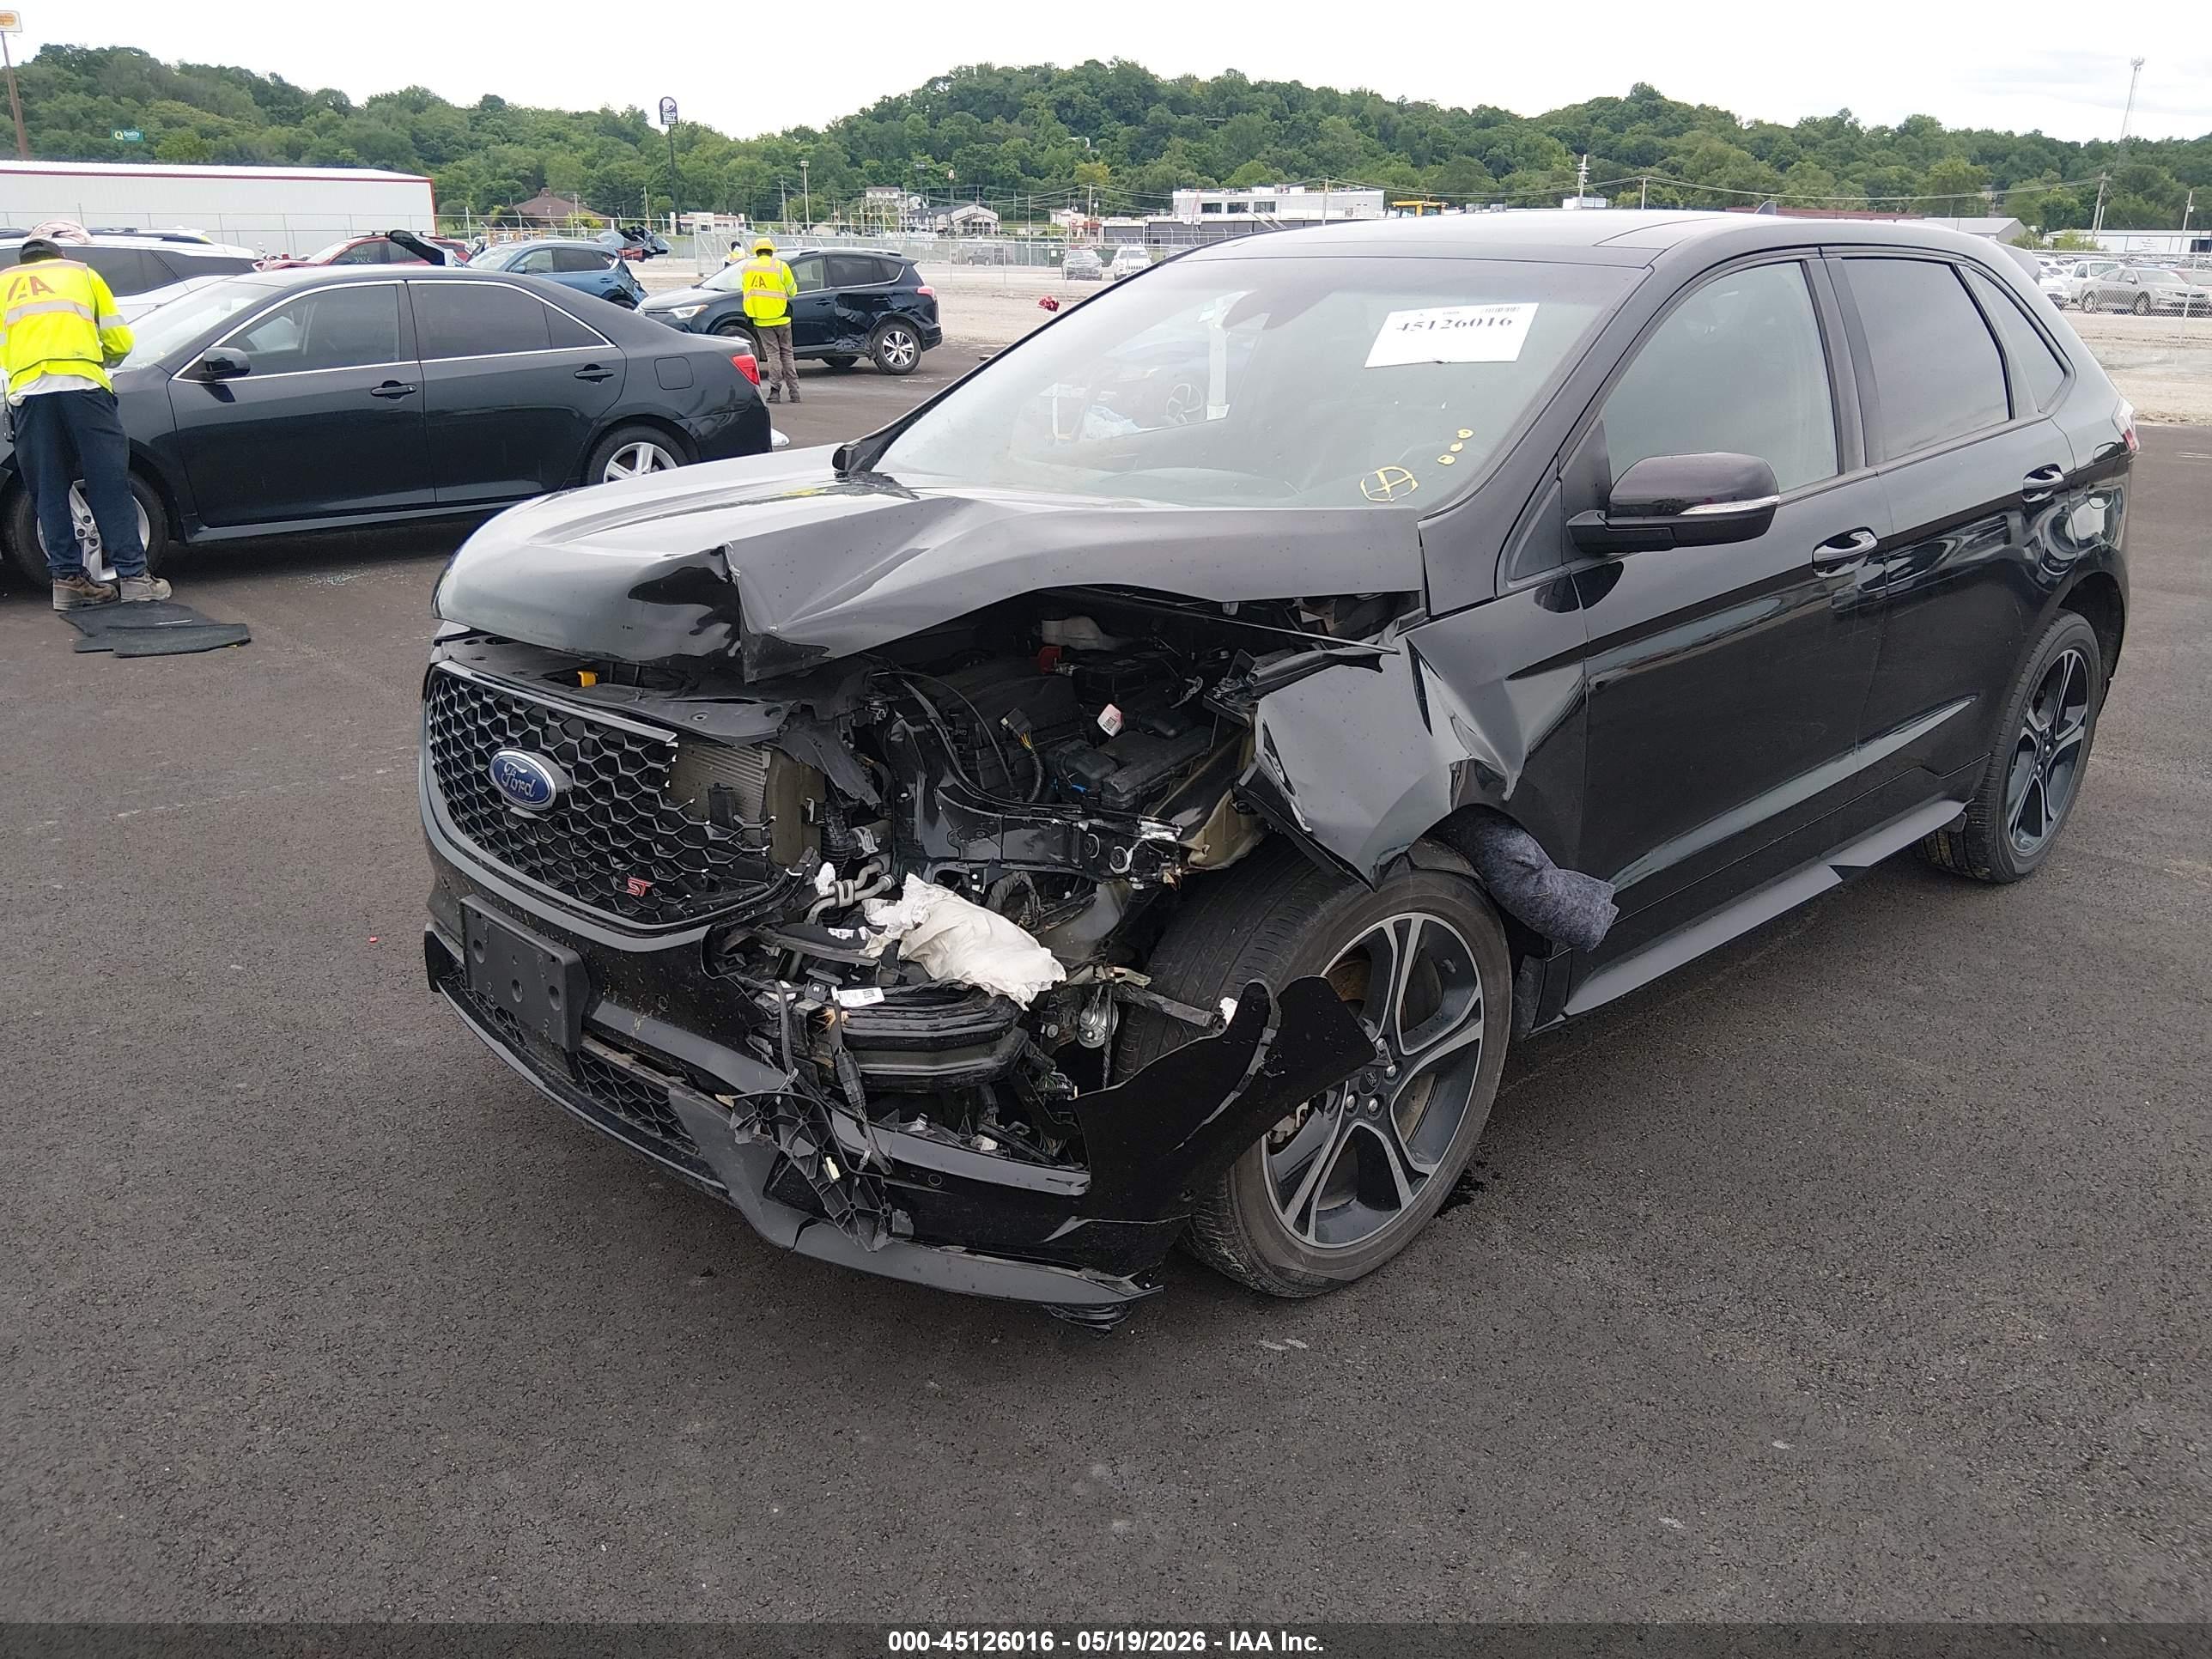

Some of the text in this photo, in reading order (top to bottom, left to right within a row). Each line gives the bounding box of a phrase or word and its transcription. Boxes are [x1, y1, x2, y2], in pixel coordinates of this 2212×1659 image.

[1395, 317, 1513, 331] 45126016
[501, 762, 538, 798] Ford
[628, 877, 653, 896] ST
